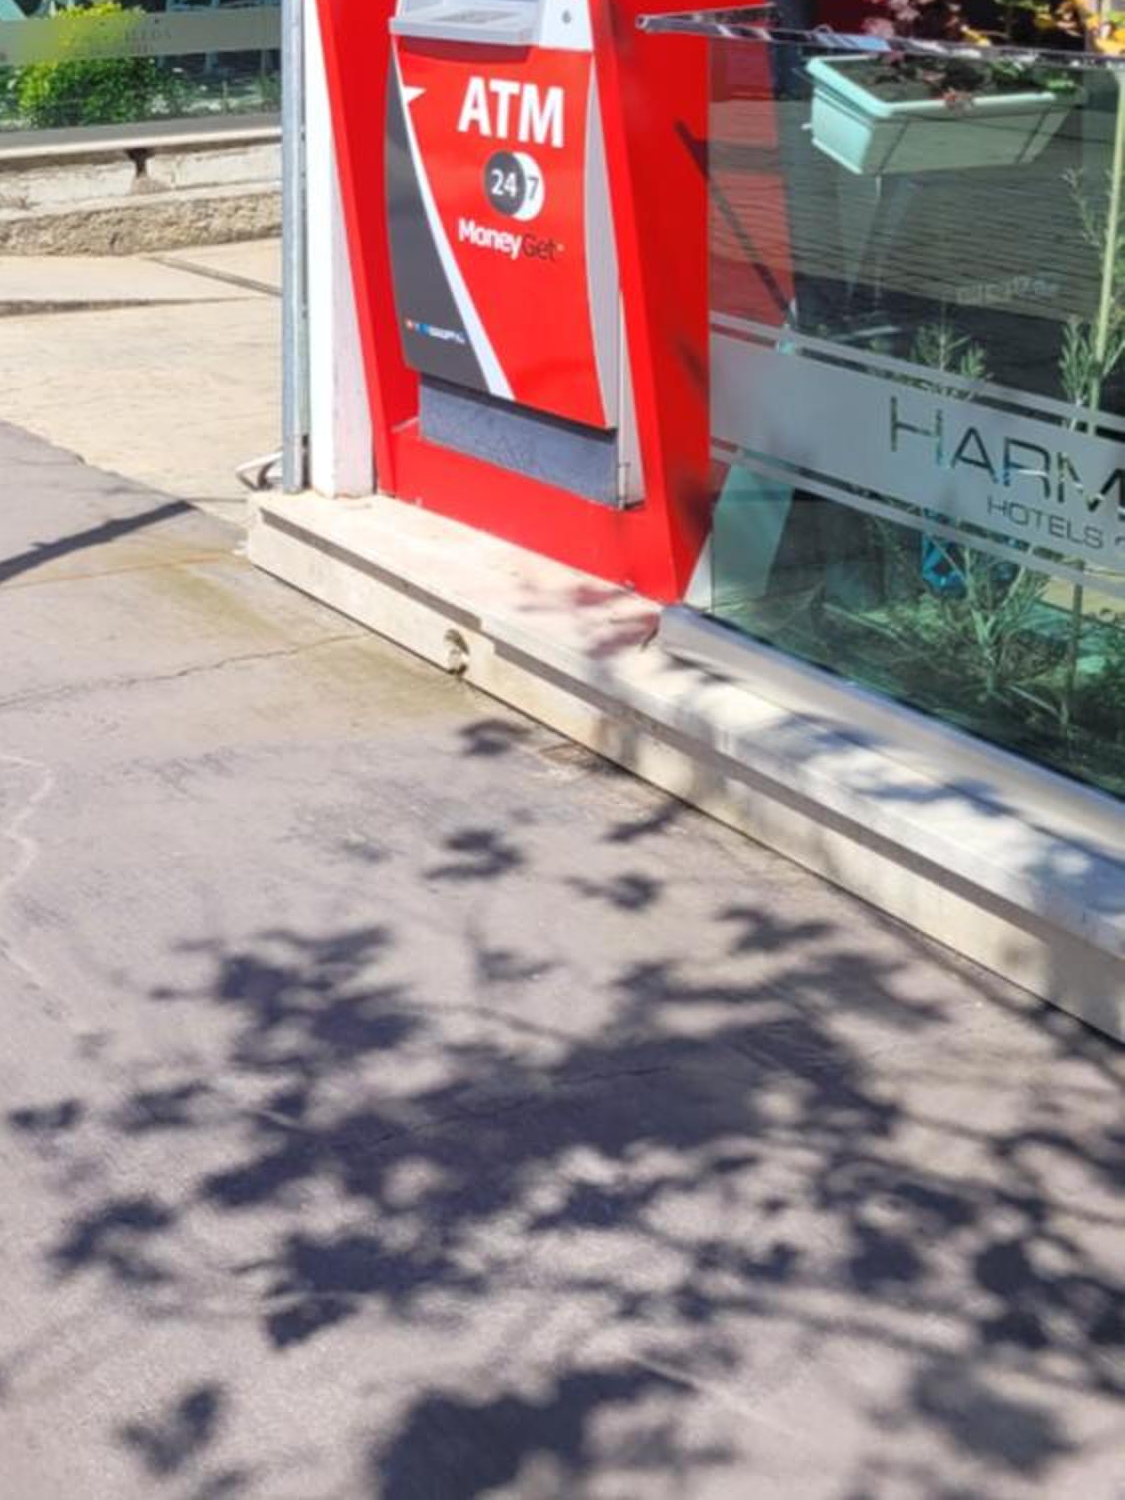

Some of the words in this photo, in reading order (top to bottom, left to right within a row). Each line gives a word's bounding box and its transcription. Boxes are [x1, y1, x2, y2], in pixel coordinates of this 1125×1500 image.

[457, 75, 565, 148] ATM
[458, 216, 559, 262] MoneyGet
[987, 495, 1104, 550] HOTELS
